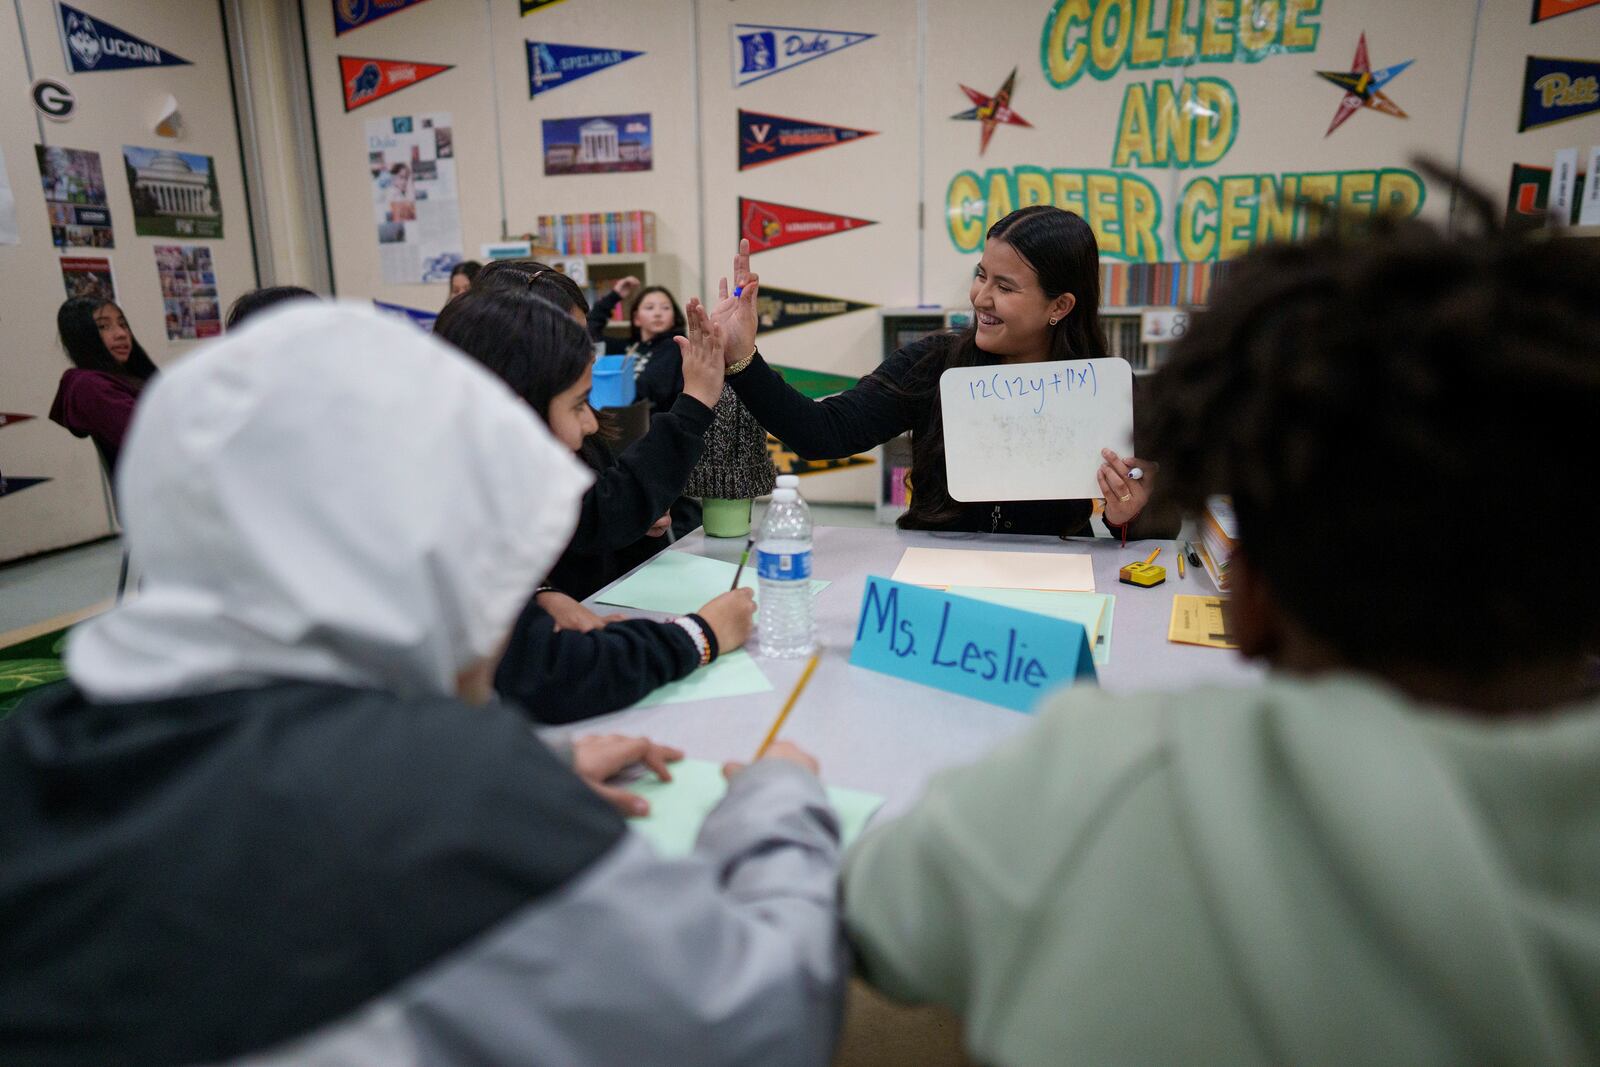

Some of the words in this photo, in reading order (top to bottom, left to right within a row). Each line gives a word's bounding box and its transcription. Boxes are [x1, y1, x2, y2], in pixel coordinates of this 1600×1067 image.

[100, 36, 162, 64] UCONN
[784, 32, 829, 56] Duke
[1040, 0, 1321, 90] COLLEGE
[561, 50, 622, 71] SPELMAN
[33, 81, 74, 116] G
[1534, 72, 1599, 108] Pitt
[750, 123, 771, 143] V
[1111, 76, 1240, 169] AND
[1170, 313, 1187, 338] 8
[856, 581, 917, 658] Ms.
[931, 601, 1049, 688] Leslie
